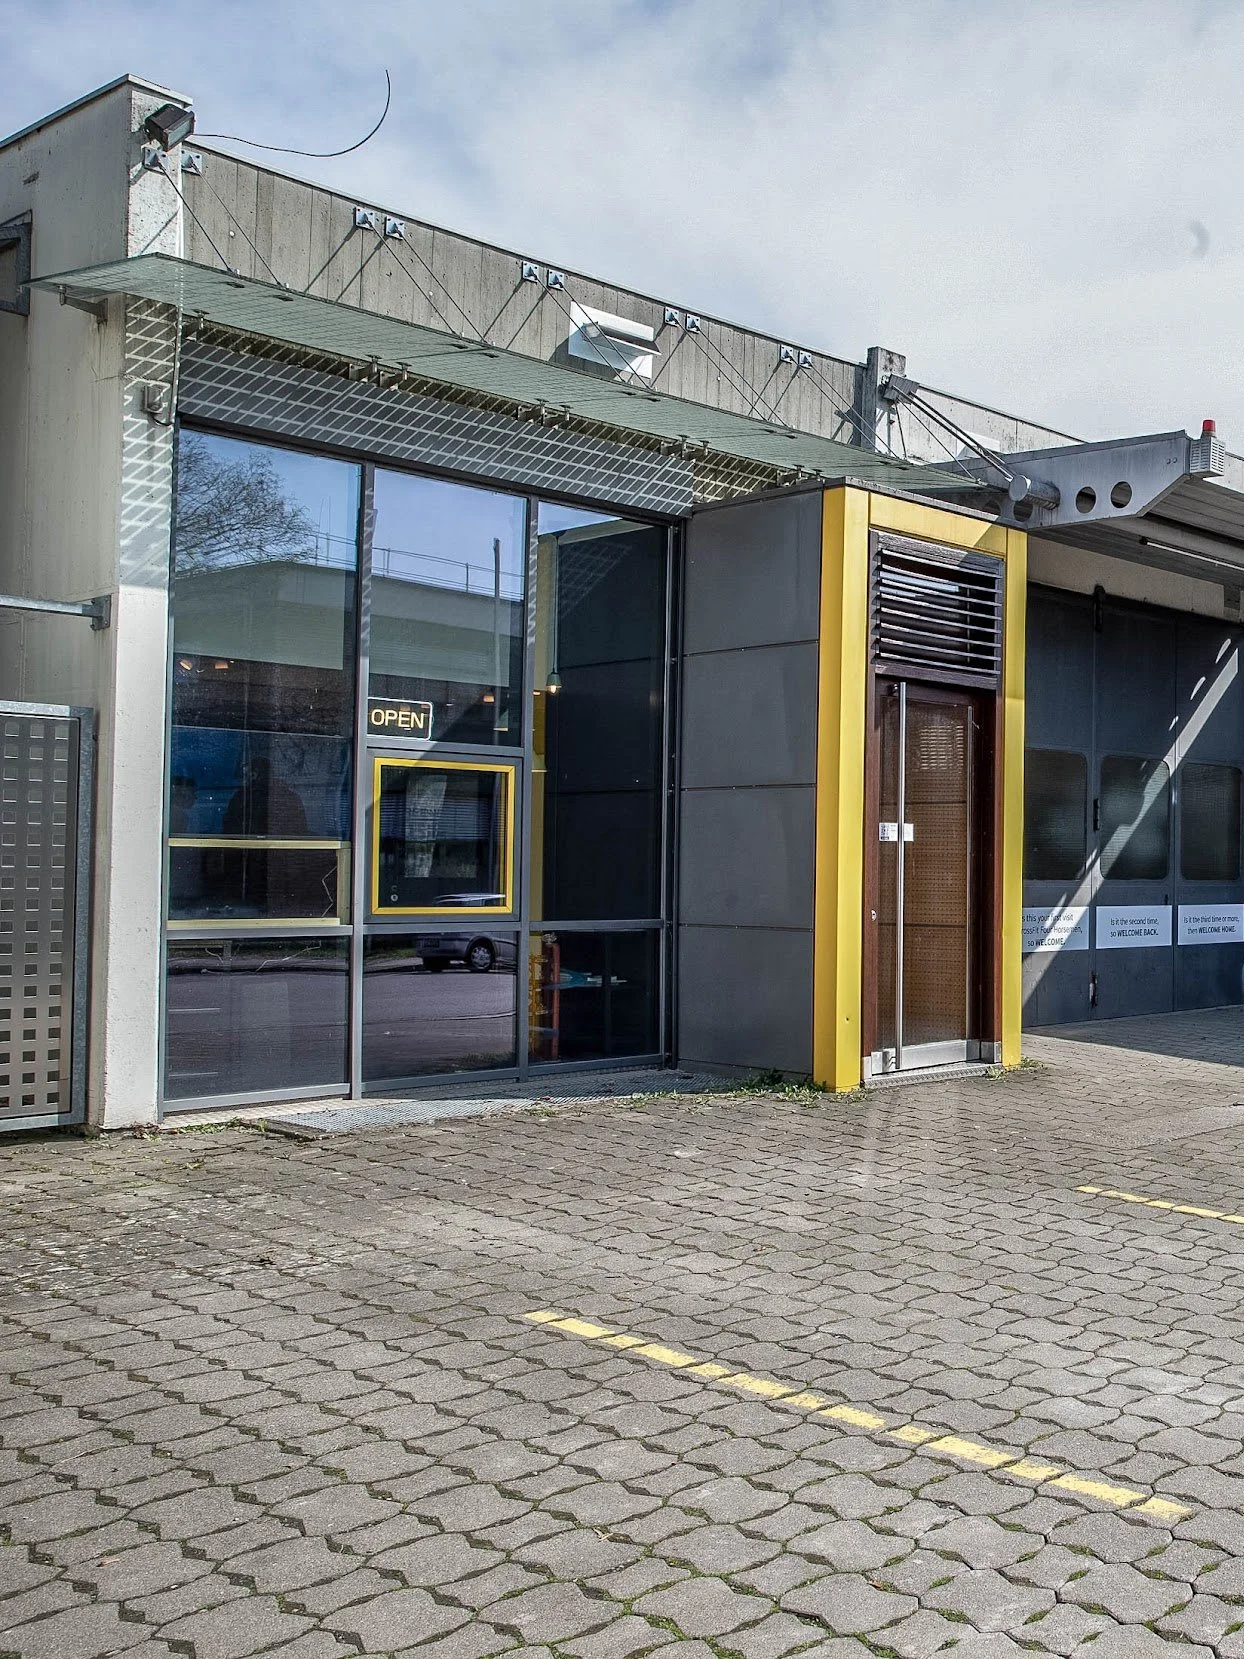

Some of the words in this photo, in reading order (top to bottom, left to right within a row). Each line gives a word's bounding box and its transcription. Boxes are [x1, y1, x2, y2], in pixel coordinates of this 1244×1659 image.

[371, 709, 424, 729] OPEN
[1026, 913, 1037, 922] this
[1129, 916, 1146, 925] second
[1117, 929, 1143, 937] WELCOME
[1198, 926, 1221, 934] WELCOME
